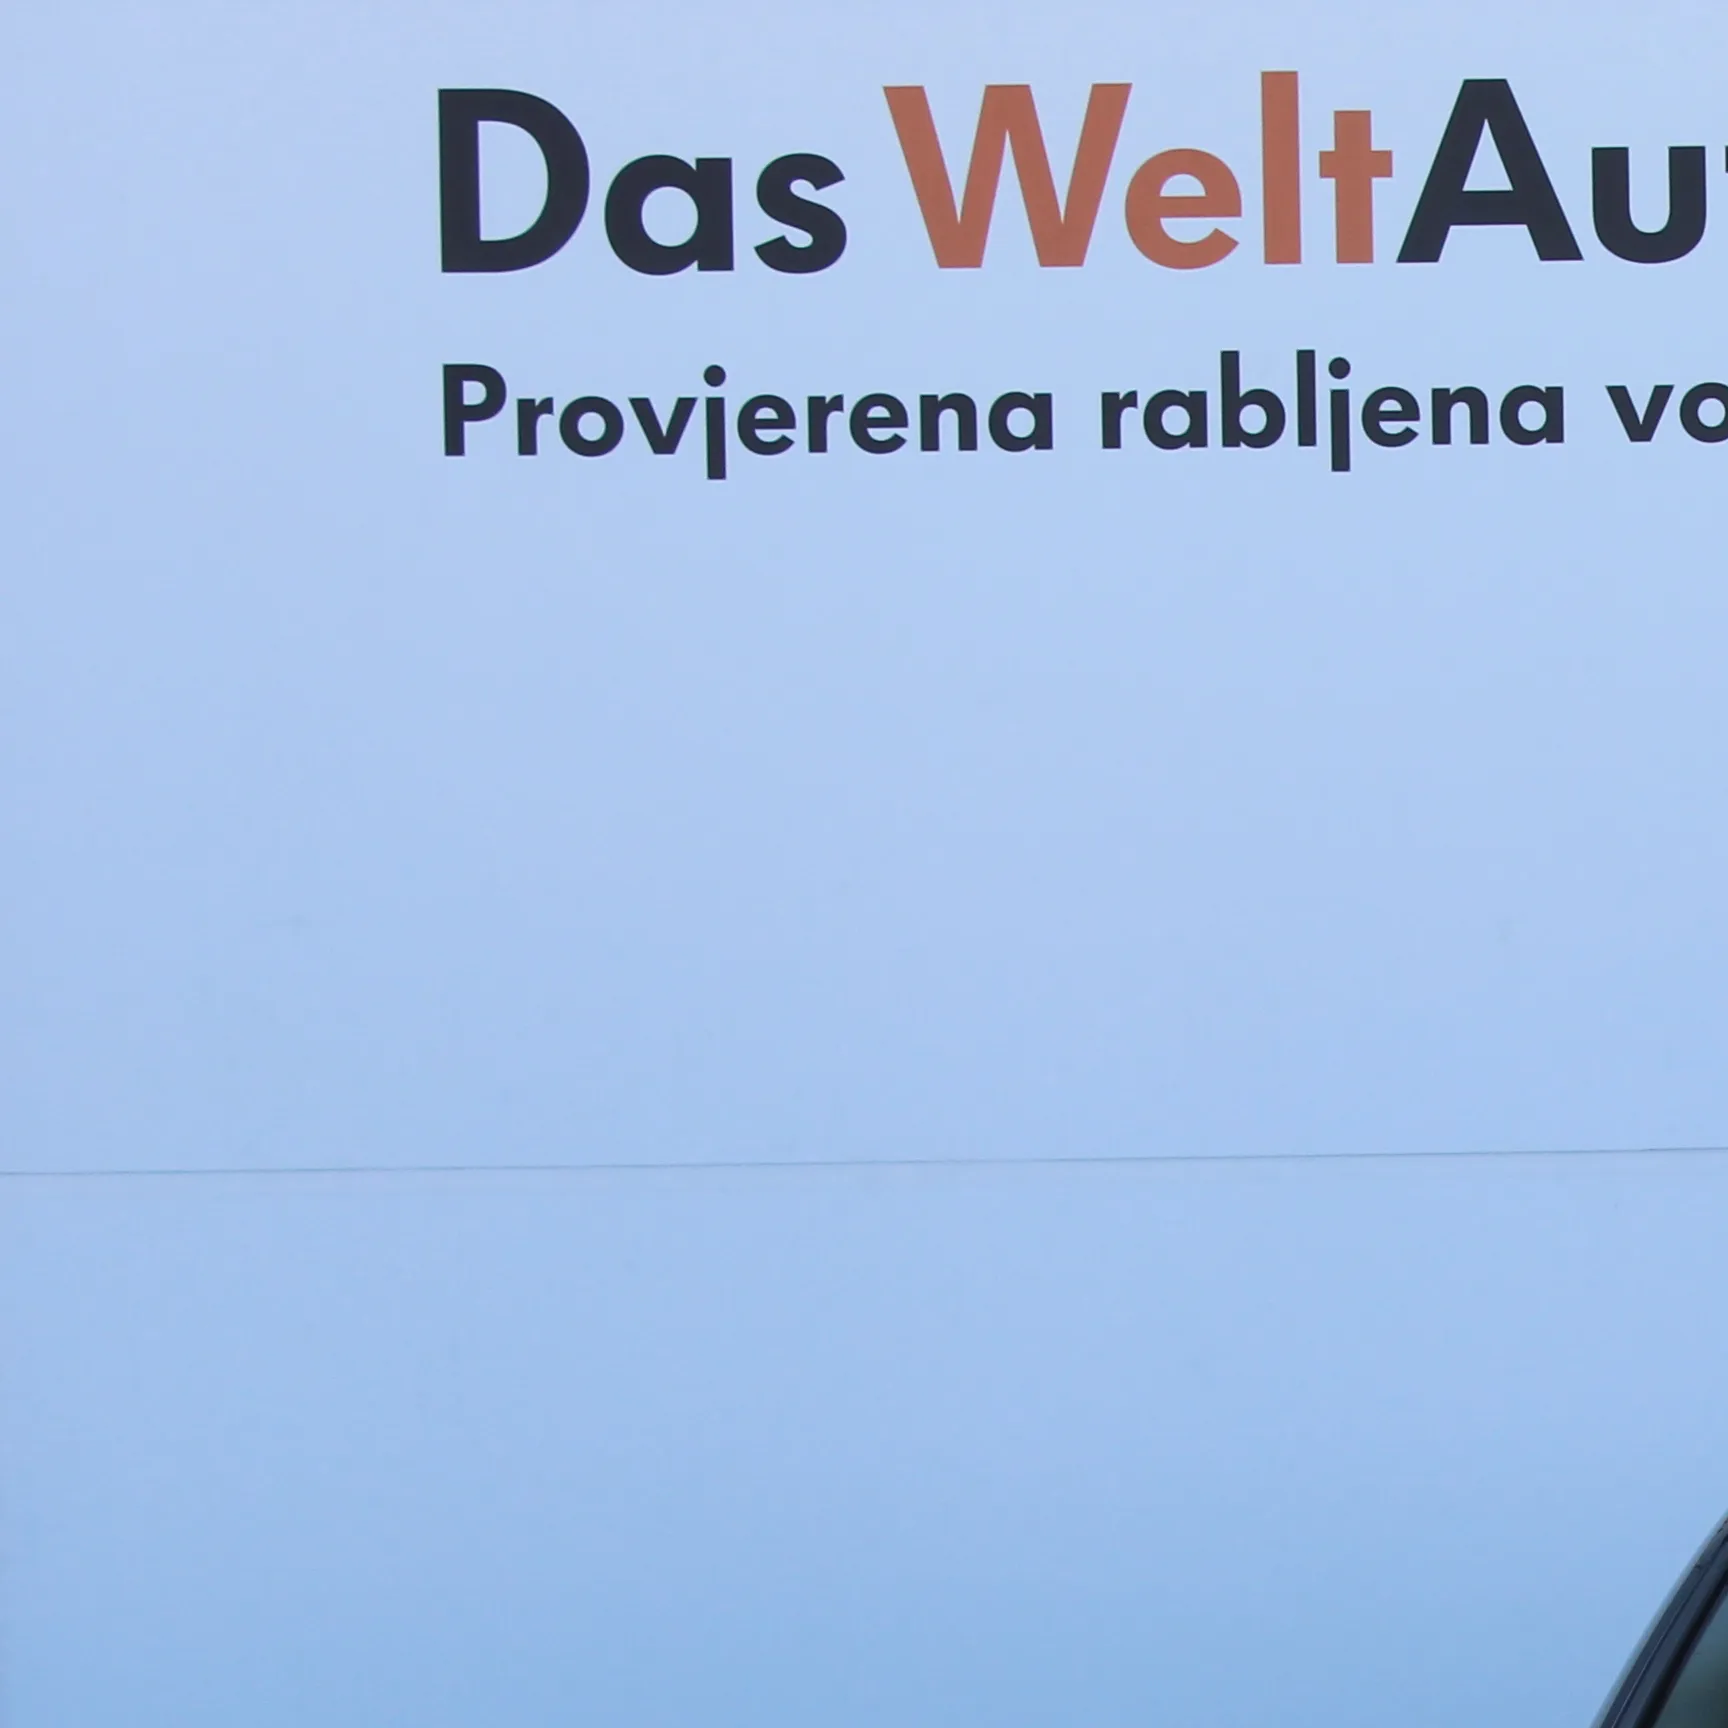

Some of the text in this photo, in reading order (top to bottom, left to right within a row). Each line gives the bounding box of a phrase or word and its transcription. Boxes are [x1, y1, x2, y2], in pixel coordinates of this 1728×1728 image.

[438, 88, 847, 275] Das
[443, 364, 1054, 481] Provjerena
[1102, 349, 1565, 473] rabljena
